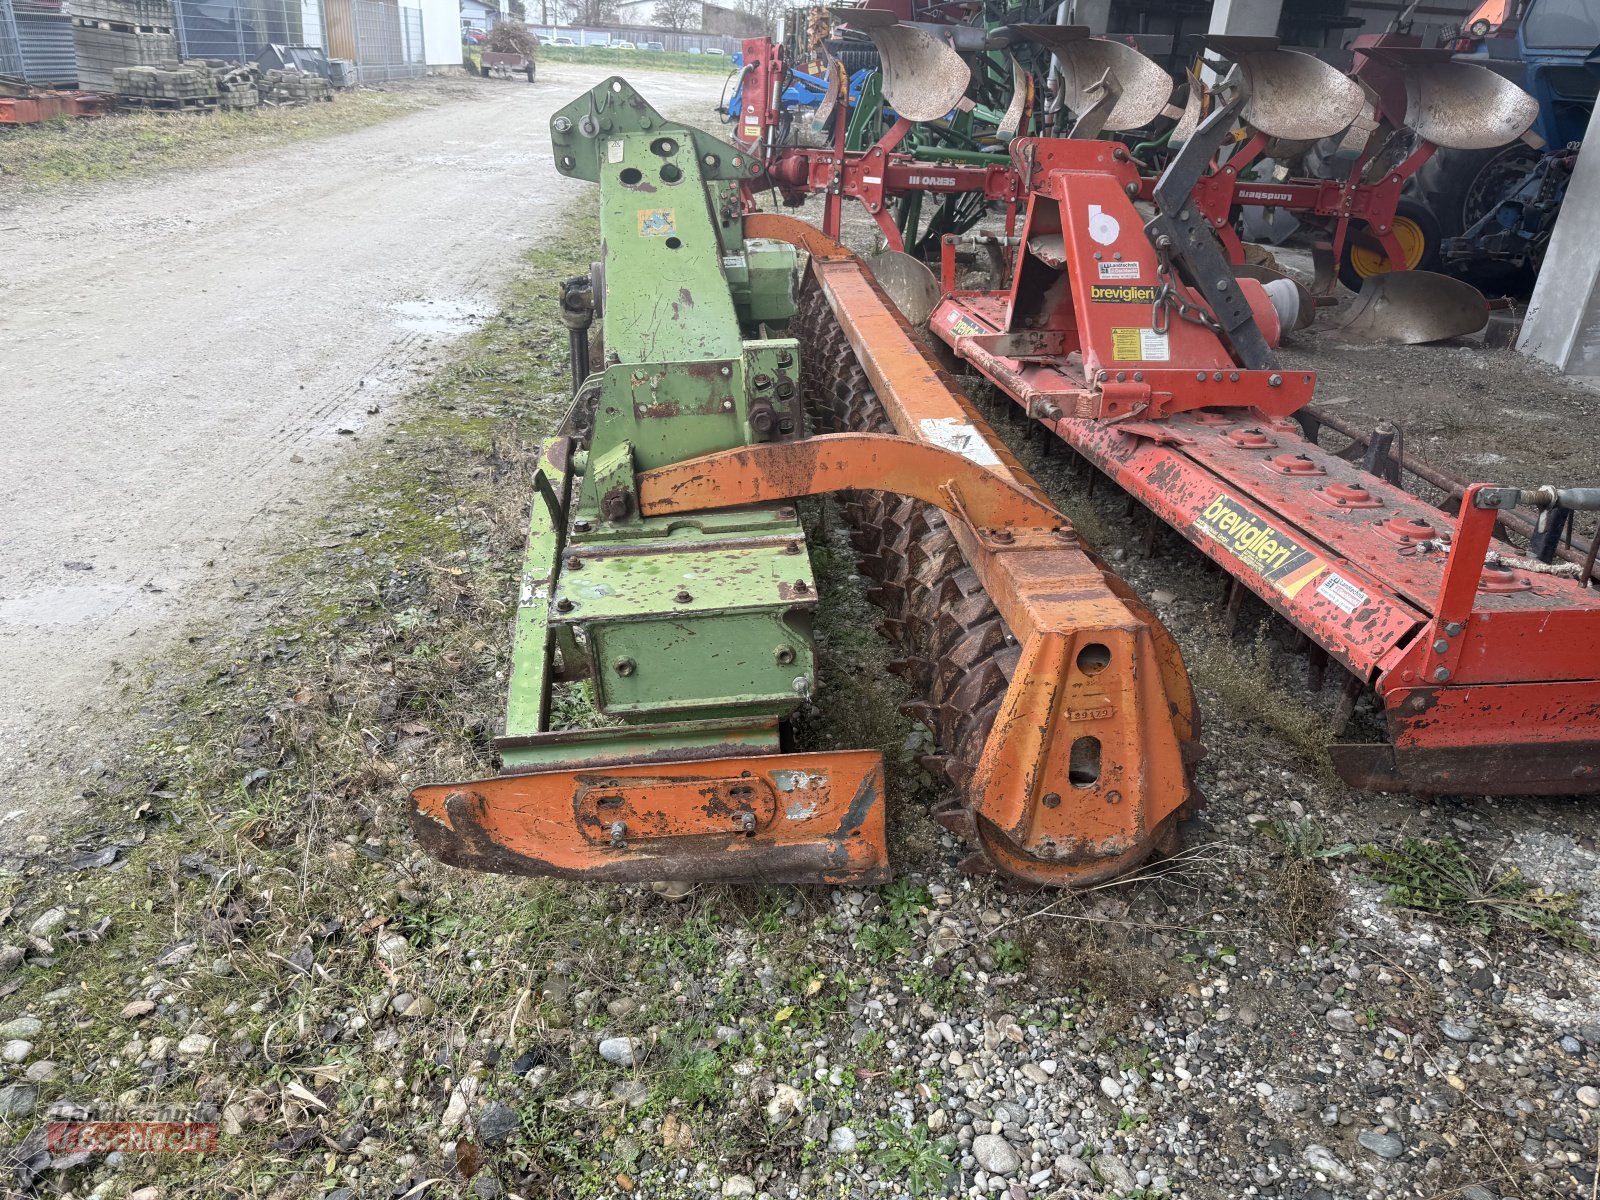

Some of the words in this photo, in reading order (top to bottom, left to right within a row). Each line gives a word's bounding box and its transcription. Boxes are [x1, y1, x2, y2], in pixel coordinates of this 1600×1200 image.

[909, 175, 920, 185] III
[922, 176, 956, 187] SERVO
[1238, 190, 1293, 202] Landsberg
[1091, 286, 1155, 301] breviglieri
[1202, 494, 1297, 569] breviglieri
